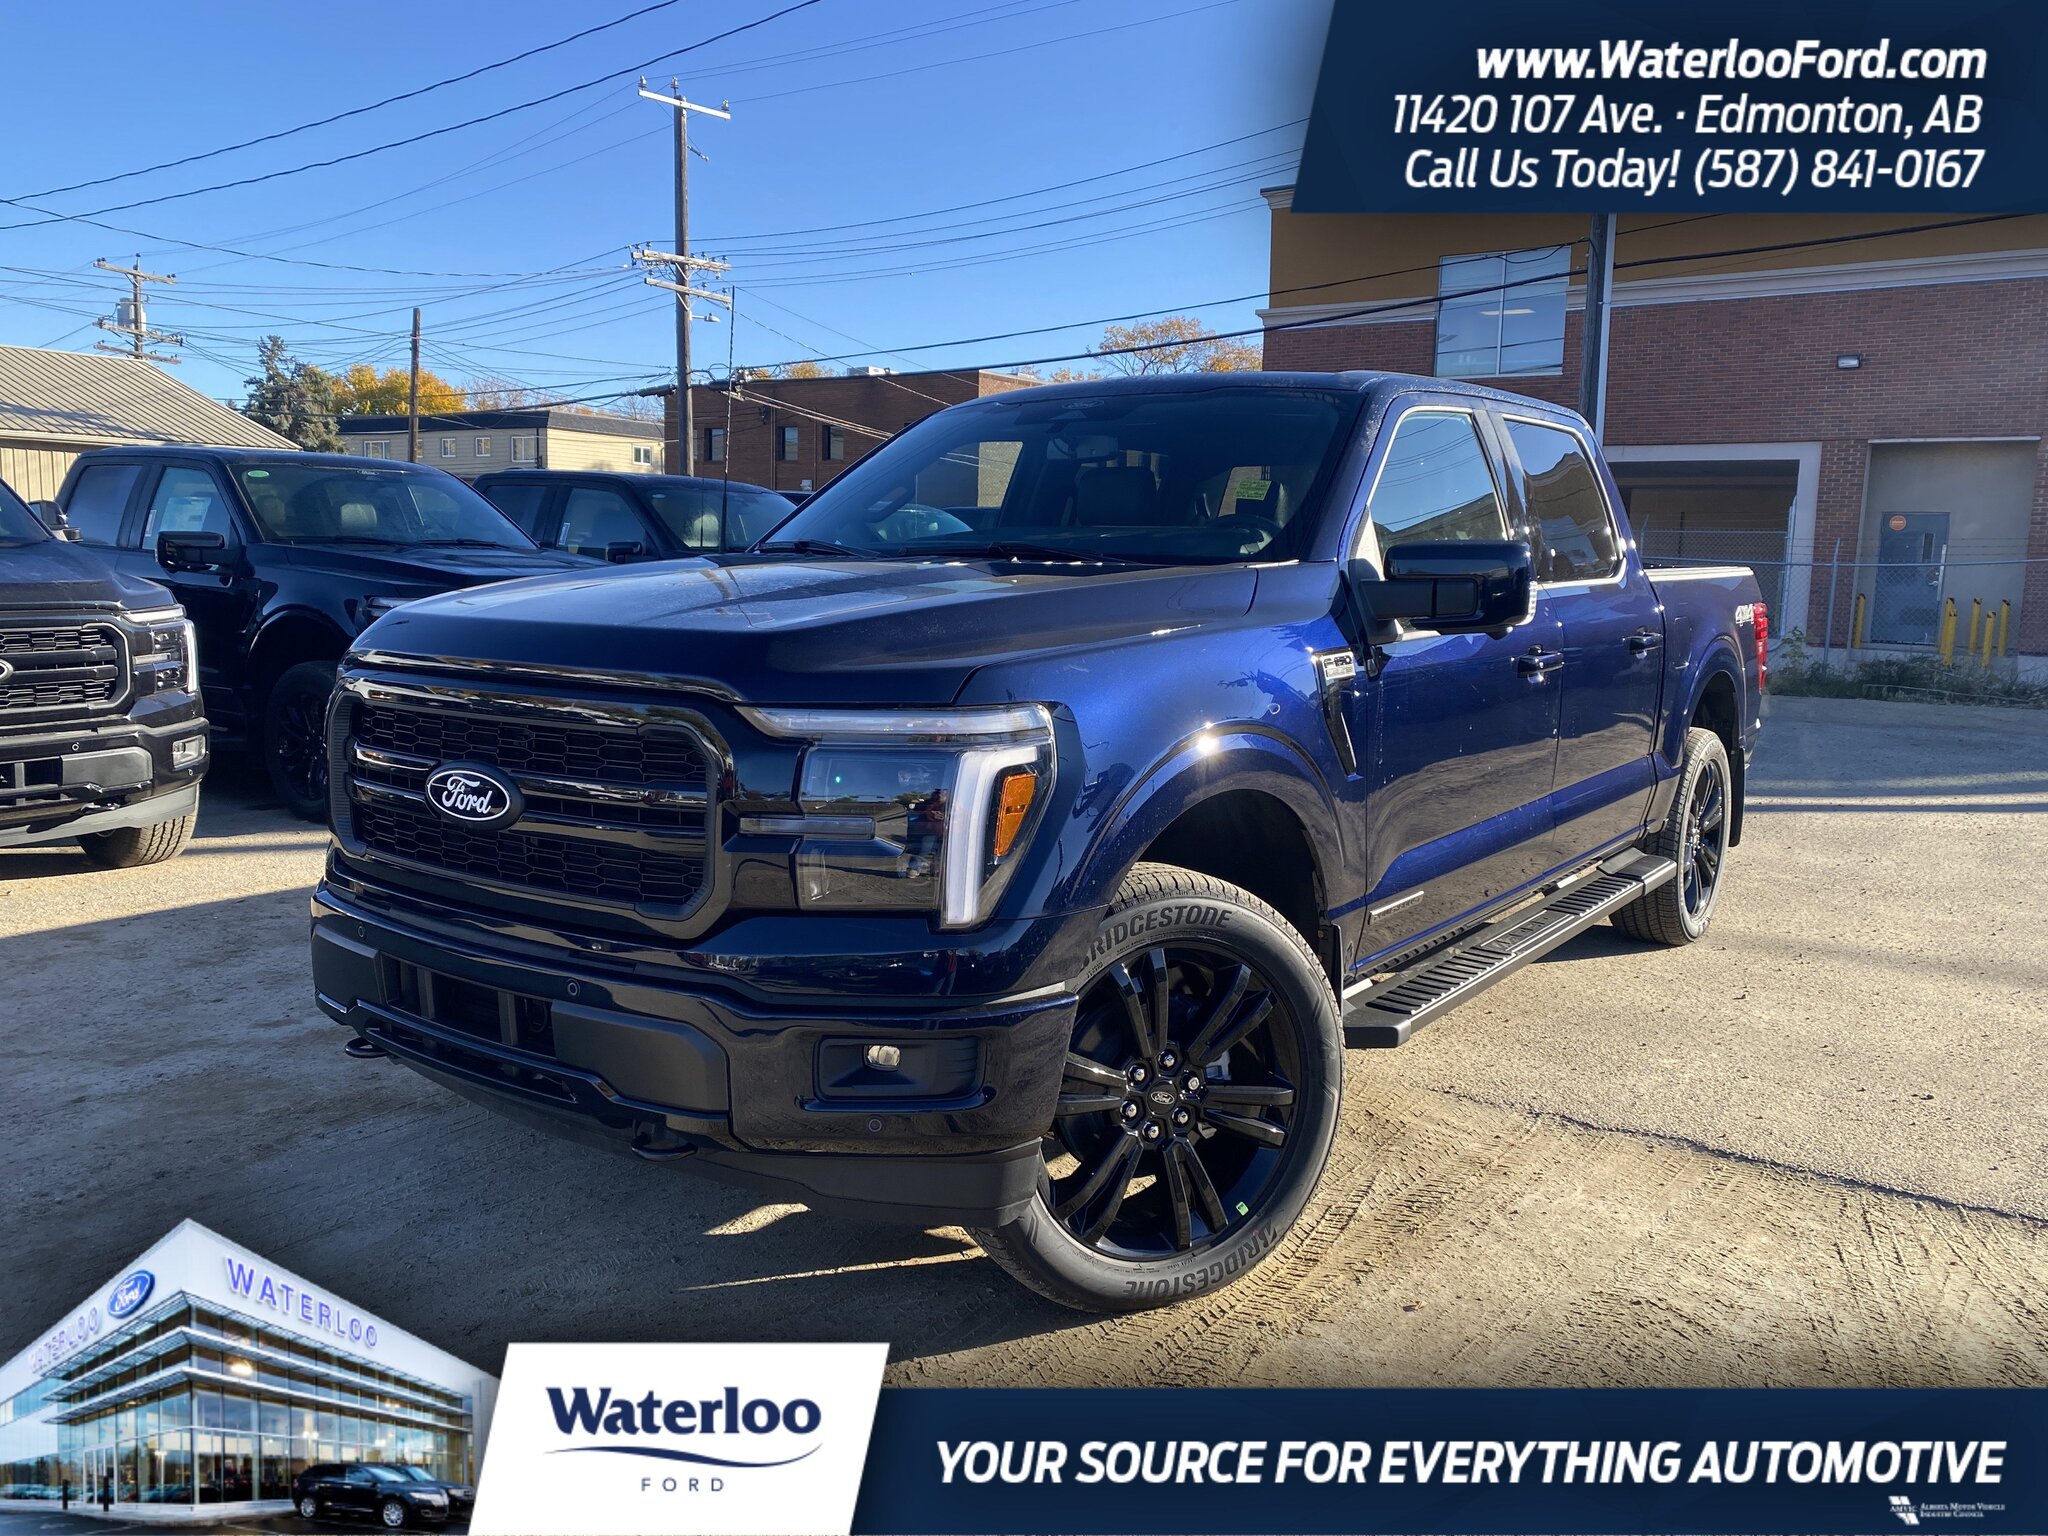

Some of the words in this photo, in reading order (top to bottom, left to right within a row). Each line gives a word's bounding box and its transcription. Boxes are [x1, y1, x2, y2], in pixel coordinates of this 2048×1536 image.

[441, 775, 494, 815] Ford
[1082, 905, 1233, 967] RIDGESTONE
[1123, 1219, 1278, 1298] BRIDGESTONE
